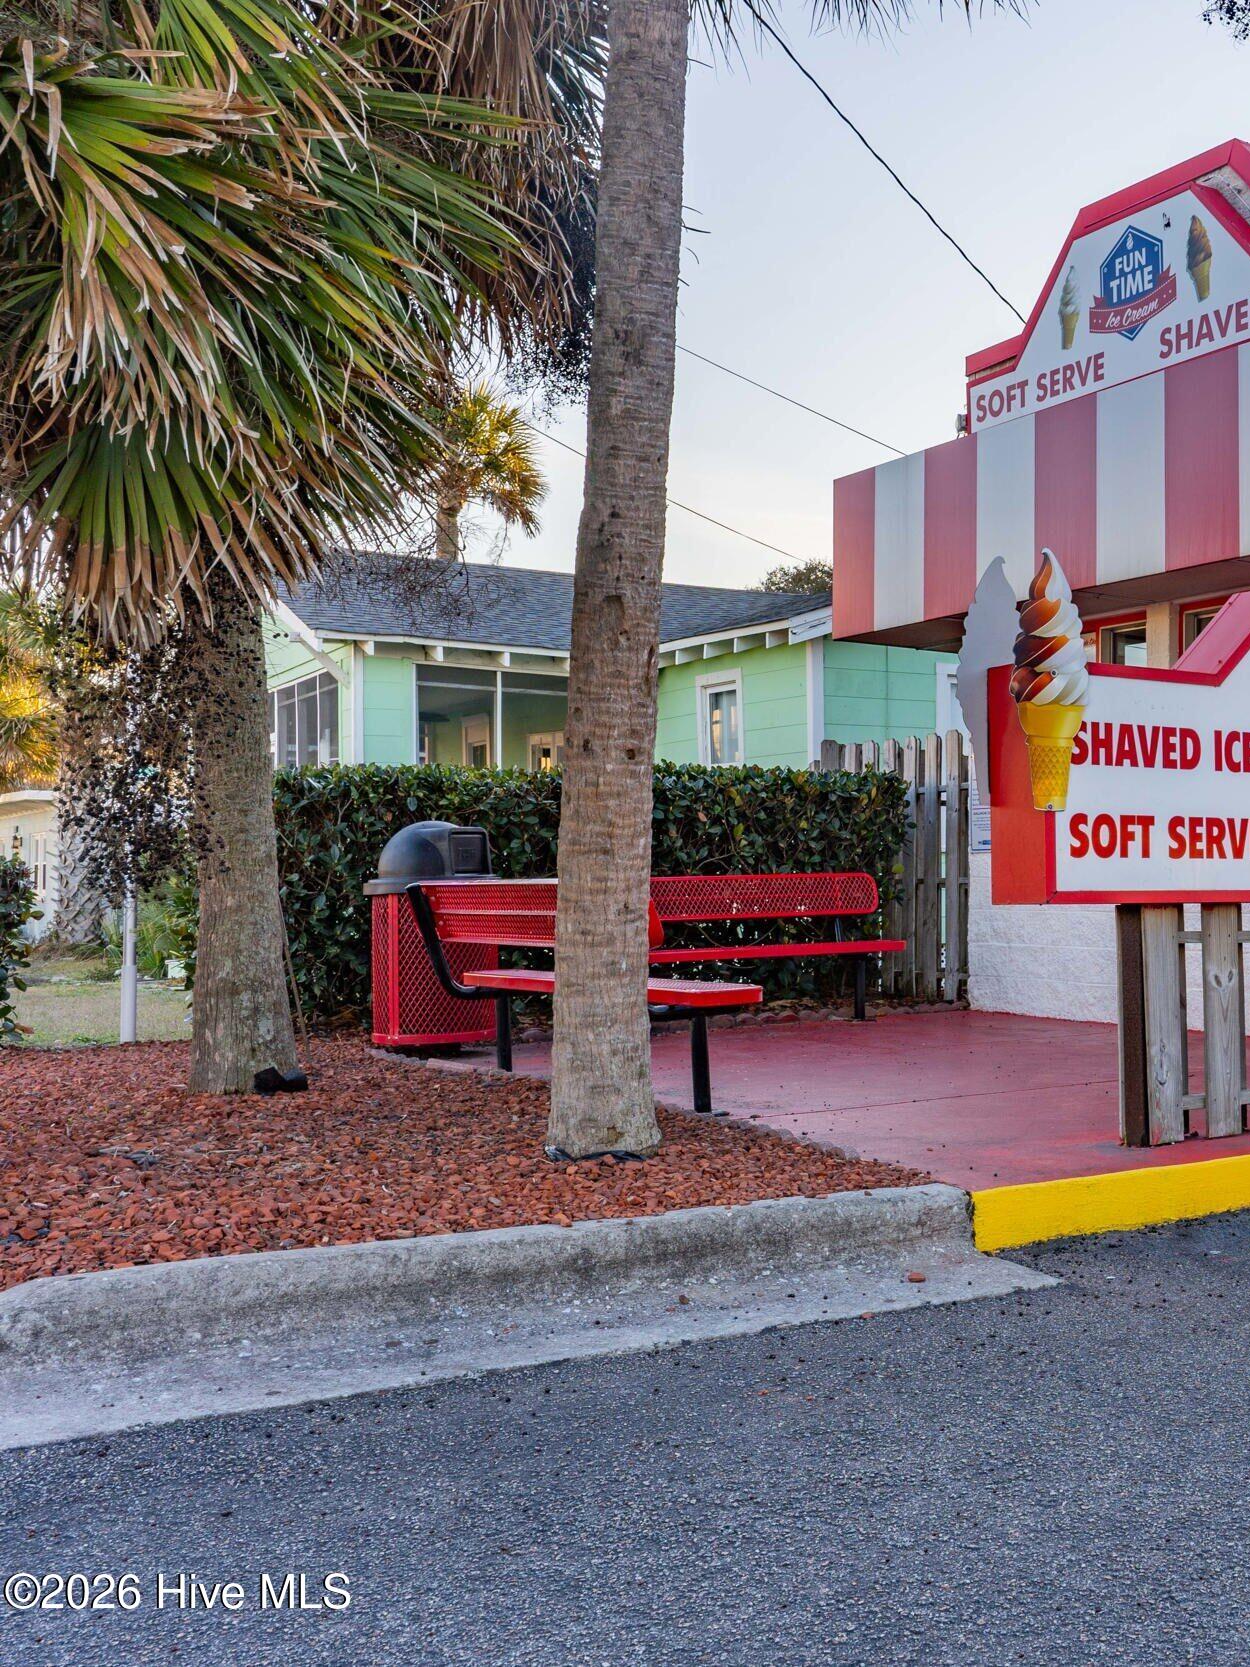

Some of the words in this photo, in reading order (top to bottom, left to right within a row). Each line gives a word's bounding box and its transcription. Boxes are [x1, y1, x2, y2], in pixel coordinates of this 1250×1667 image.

[1115, 247, 1146, 277] FUN
[1110, 265, 1153, 303] TIME
[1106, 312, 1121, 328] Ice
[1123, 299, 1159, 326] Cream
[976, 380, 1028, 424] SOFT
[1036, 351, 1105, 402] SERVE
[1070, 720, 1202, 770] SHAVED
[1069, 812, 1155, 859] SOFT
